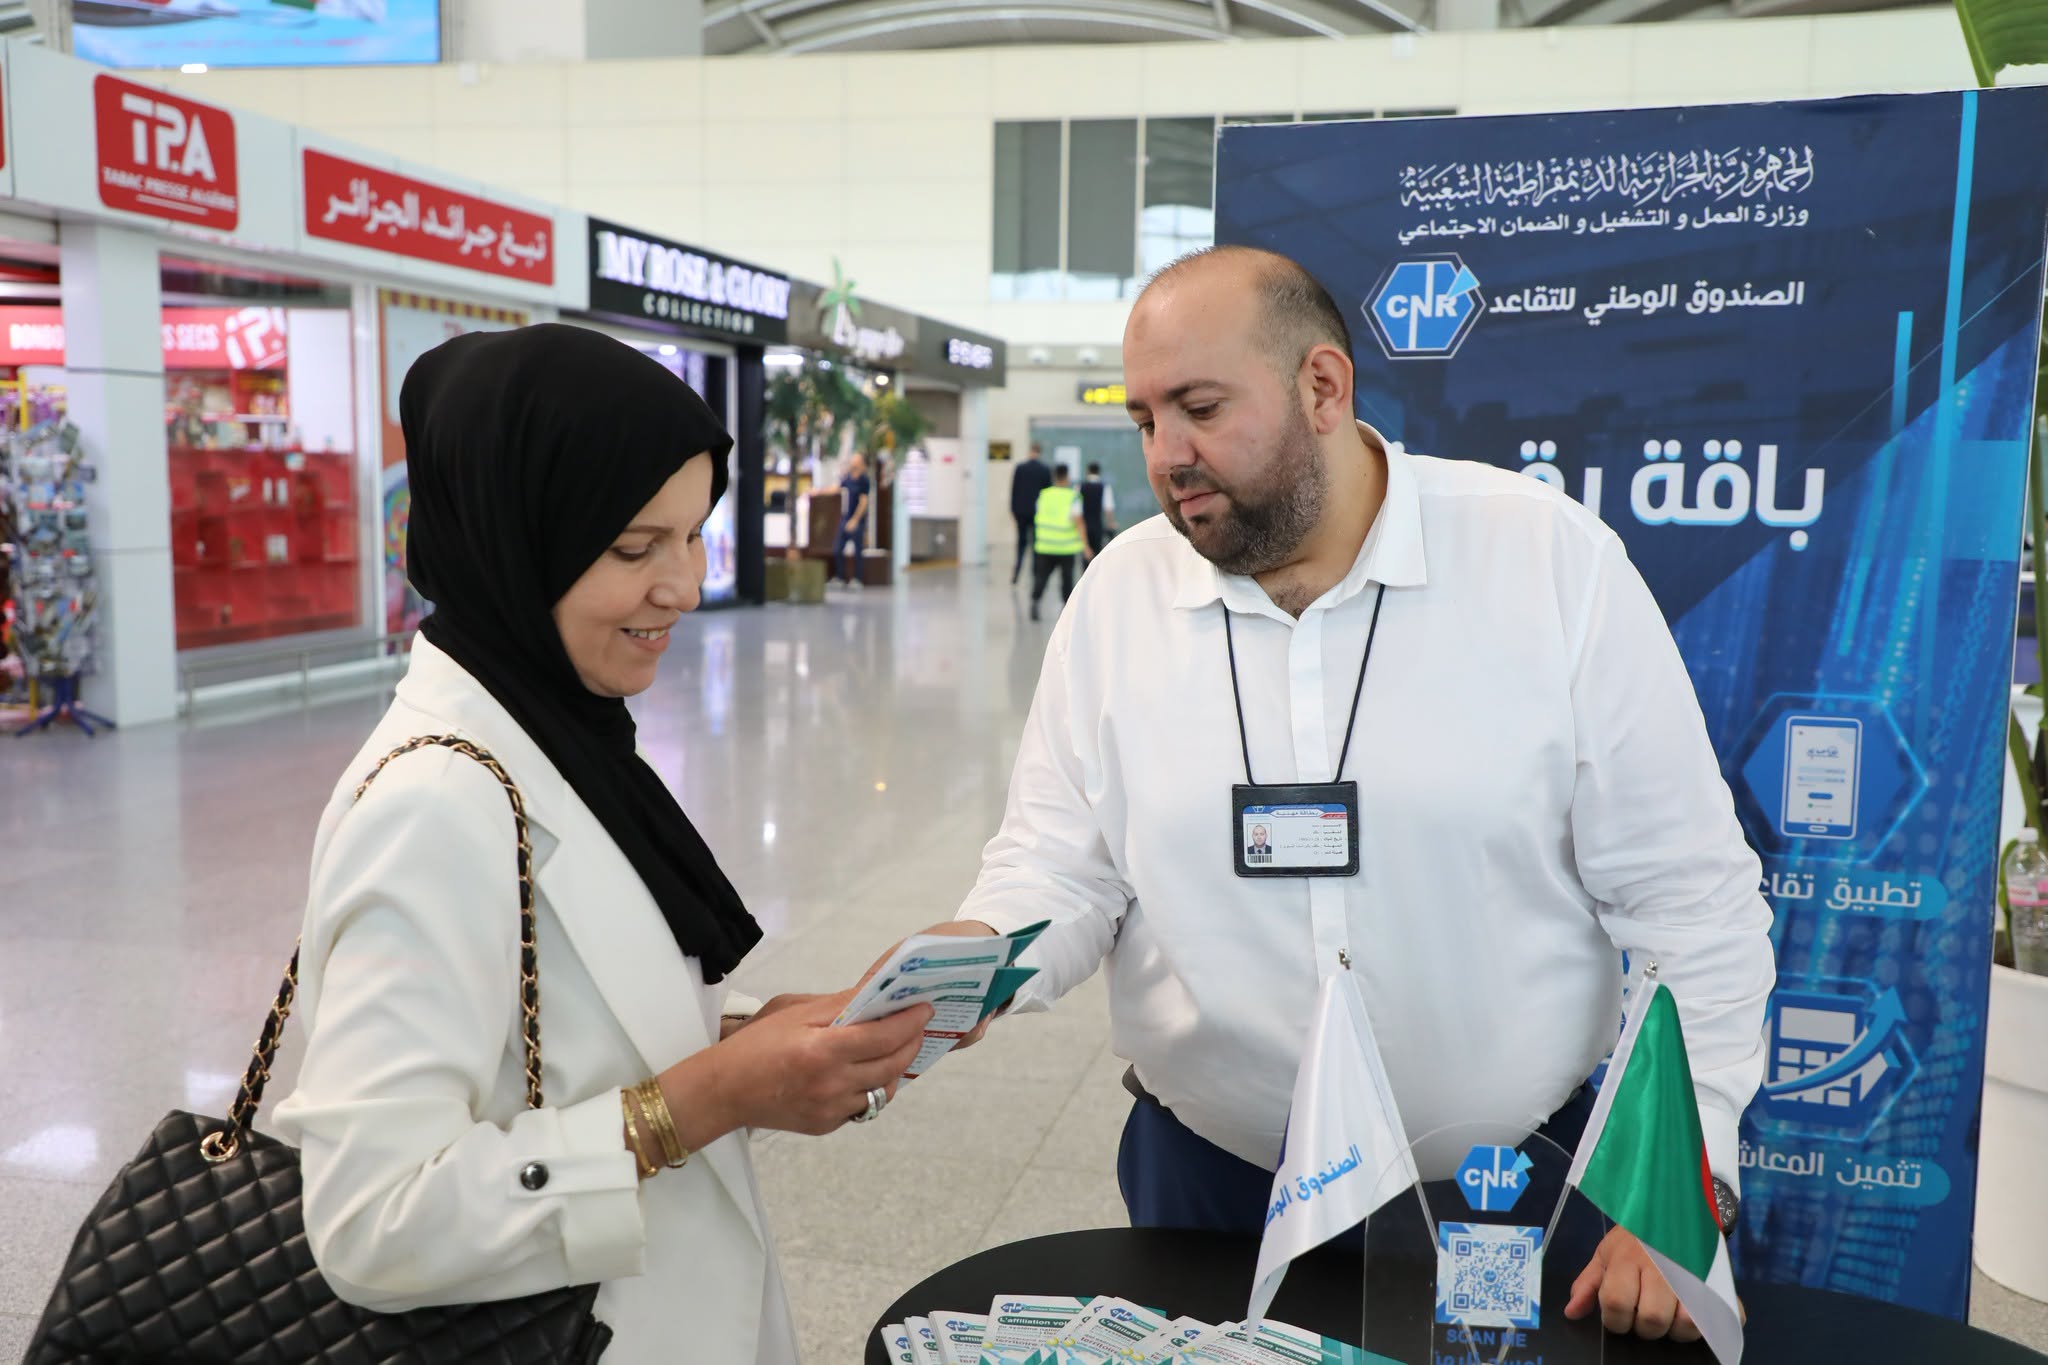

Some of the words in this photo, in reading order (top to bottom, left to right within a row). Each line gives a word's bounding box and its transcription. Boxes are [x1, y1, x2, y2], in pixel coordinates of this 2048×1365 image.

[145, 176, 190, 200] PRESSE
[322, 177, 420, 236] الجزائر
[1590, 208, 1670, 233] التشغيل
[1692, 205, 1749, 229] العمل
[1754, 204, 1809, 227] وزارة
[421, 204, 497, 259] جرائد
[1398, 217, 1496, 245] الاجتماعي
[1500, 213, 1569, 237] الضمان
[1572, 217, 1587, 235] و
[1673, 212, 1689, 230] و
[498, 221, 547, 268] تبغ
[596, 230, 649, 287] MY
[647, 243, 710, 301] ROSE
[709, 261, 726, 305] &
[726, 265, 790, 320] GLORY
[1489, 287, 1576, 315] للتقاعد
[1583, 284, 1677, 325] الوطني
[1685, 281, 1804, 314] الصندوق
[642, 293, 754, 334] COLLECTION
[176, 324, 220, 350] SECS
[1630, 439, 1825, 551] باقة
[1759, 872, 1815, 900] تقاع
[1825, 878, 1922, 912] تطبيق
[1738, 1139, 1825, 1176] المعاش
[1295, 1143, 1362, 1201] الصندوق
[1836, 1158, 1922, 1190] تثمين
[999, 1316, 1050, 1327] L'affiliation
[1101, 1319, 1141, 1339] L'affiliatio
[1446, 1328, 1495, 1345] SCAN
[1501, 1331, 1528, 1348] ME
